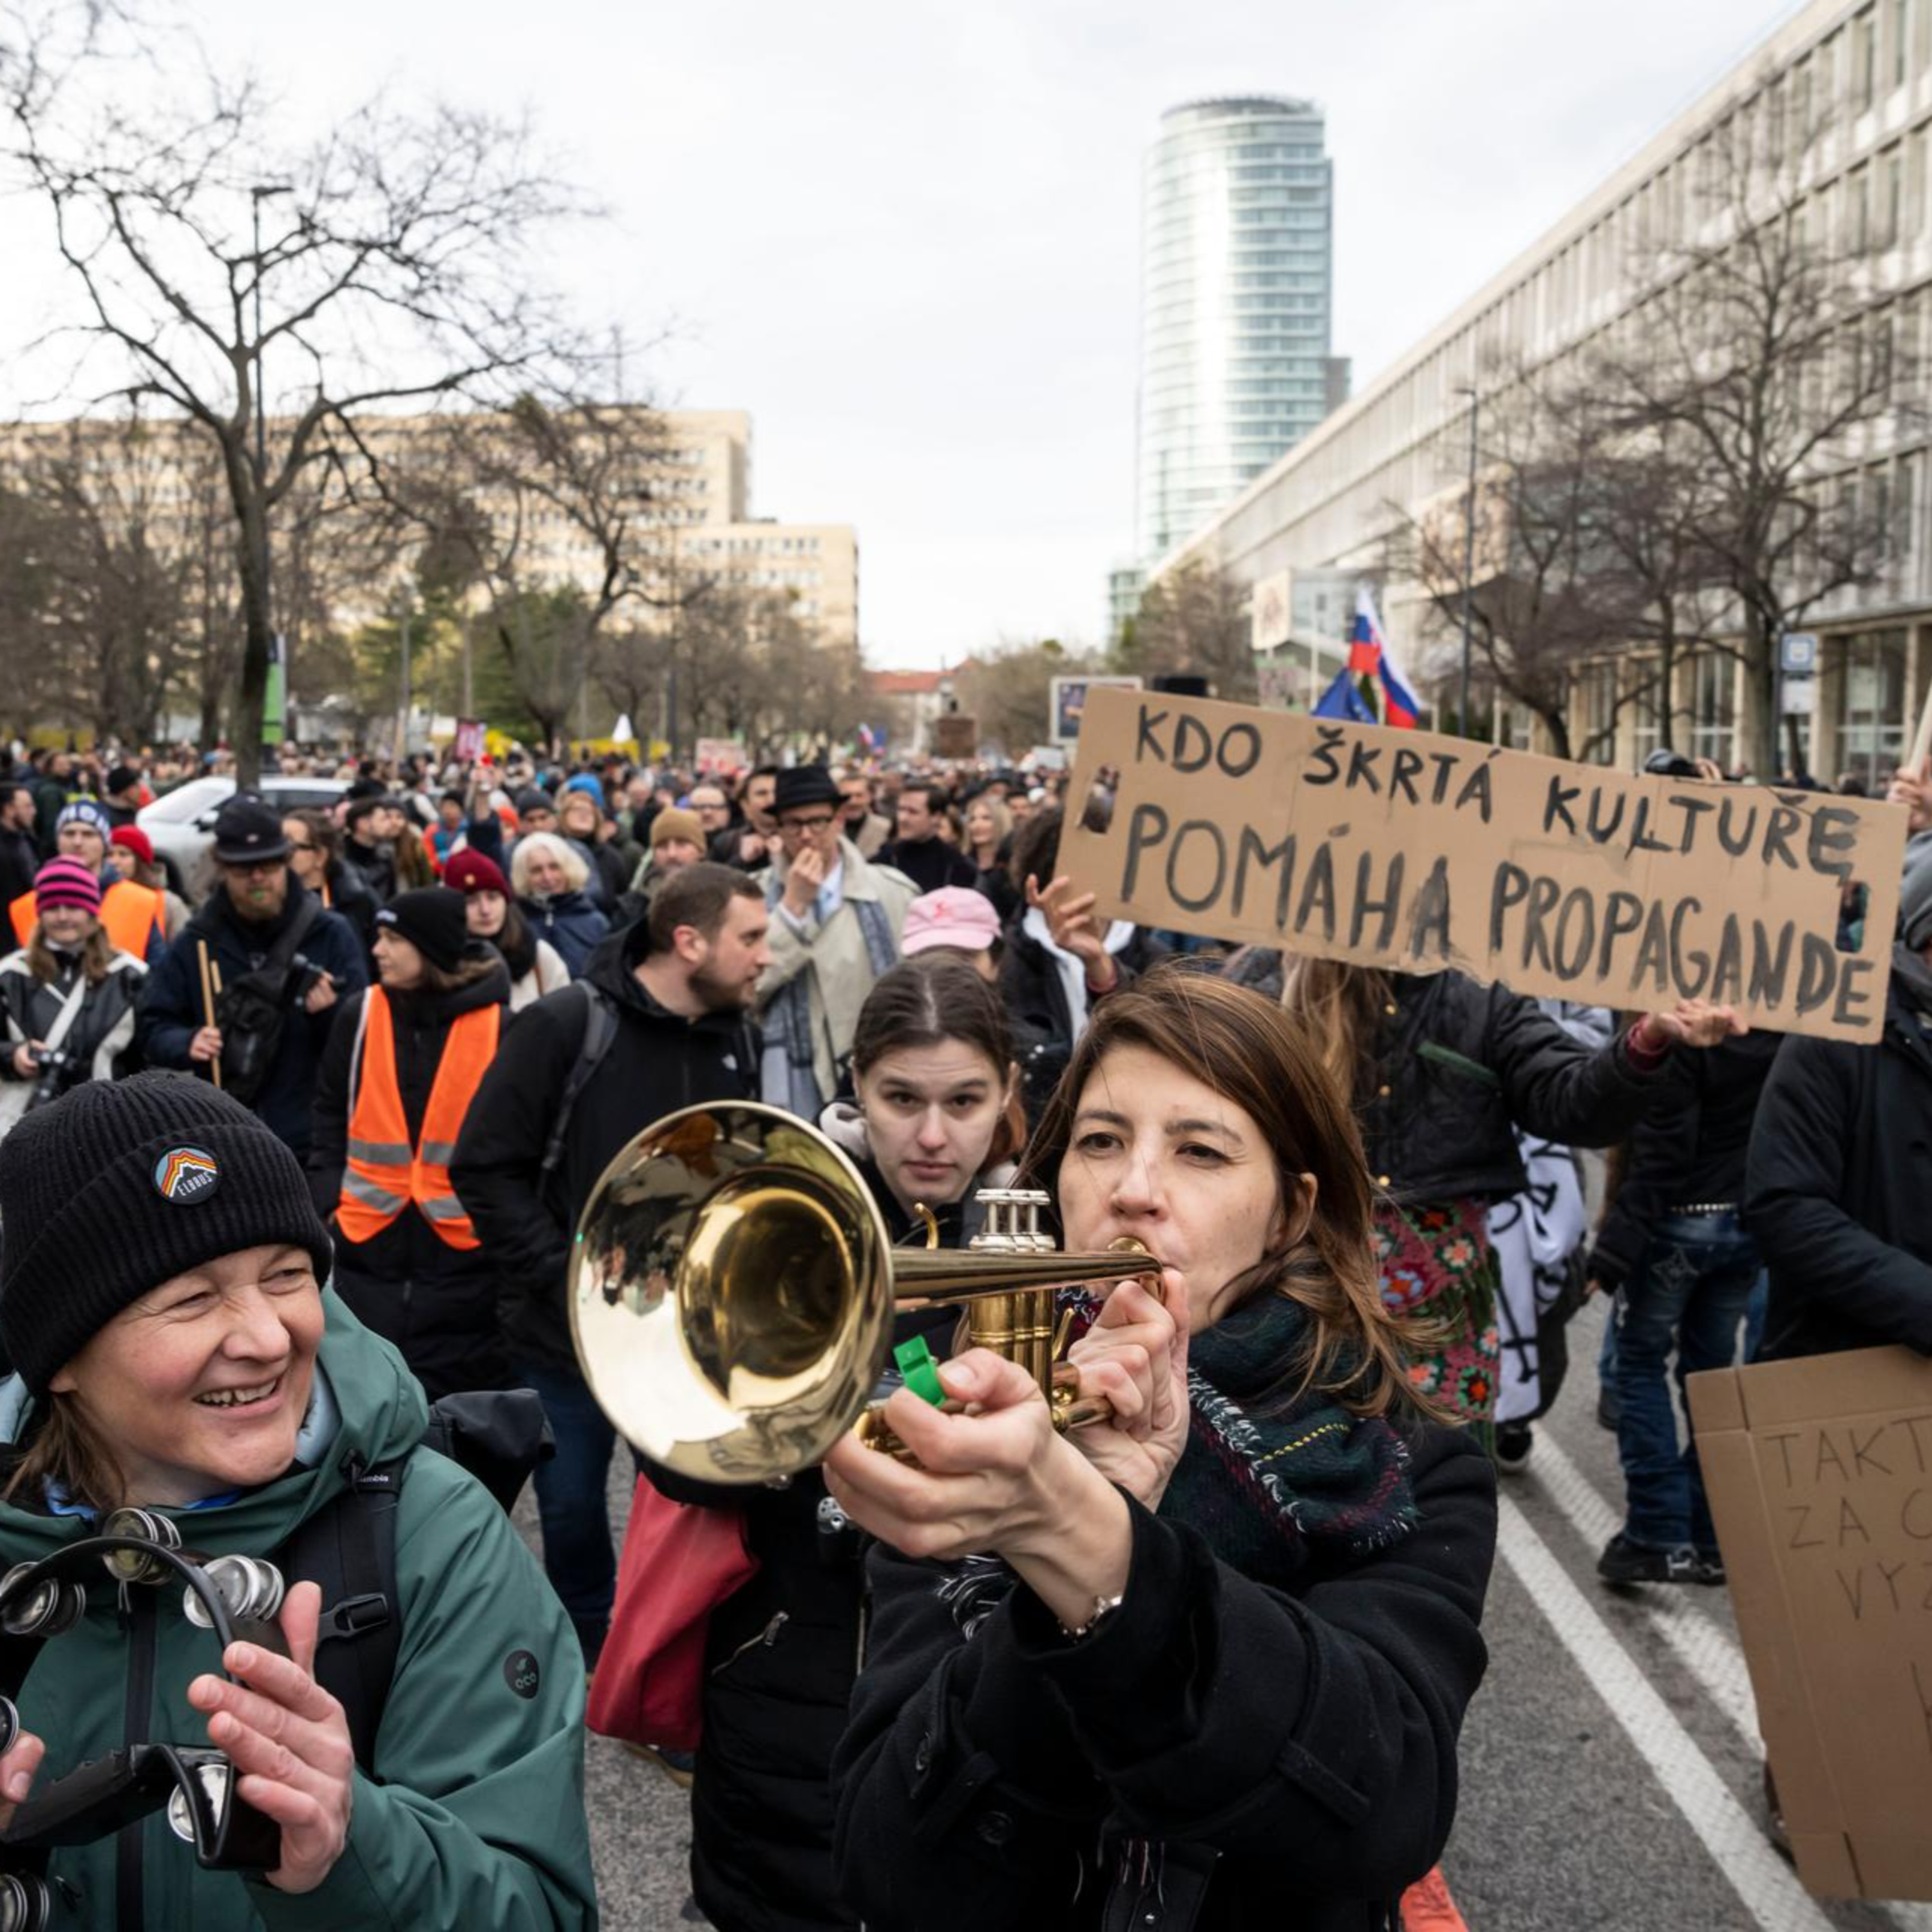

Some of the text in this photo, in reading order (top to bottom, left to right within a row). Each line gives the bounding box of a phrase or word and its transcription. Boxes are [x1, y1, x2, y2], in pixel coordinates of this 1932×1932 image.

[1136, 704, 1262, 778] KDO
[1302, 724, 1502, 824] ŠKRTÁ
[1121, 802, 1875, 1027] POMÁHA PROPAGANDE
[1785, 1495, 1871, 1549] ZA
